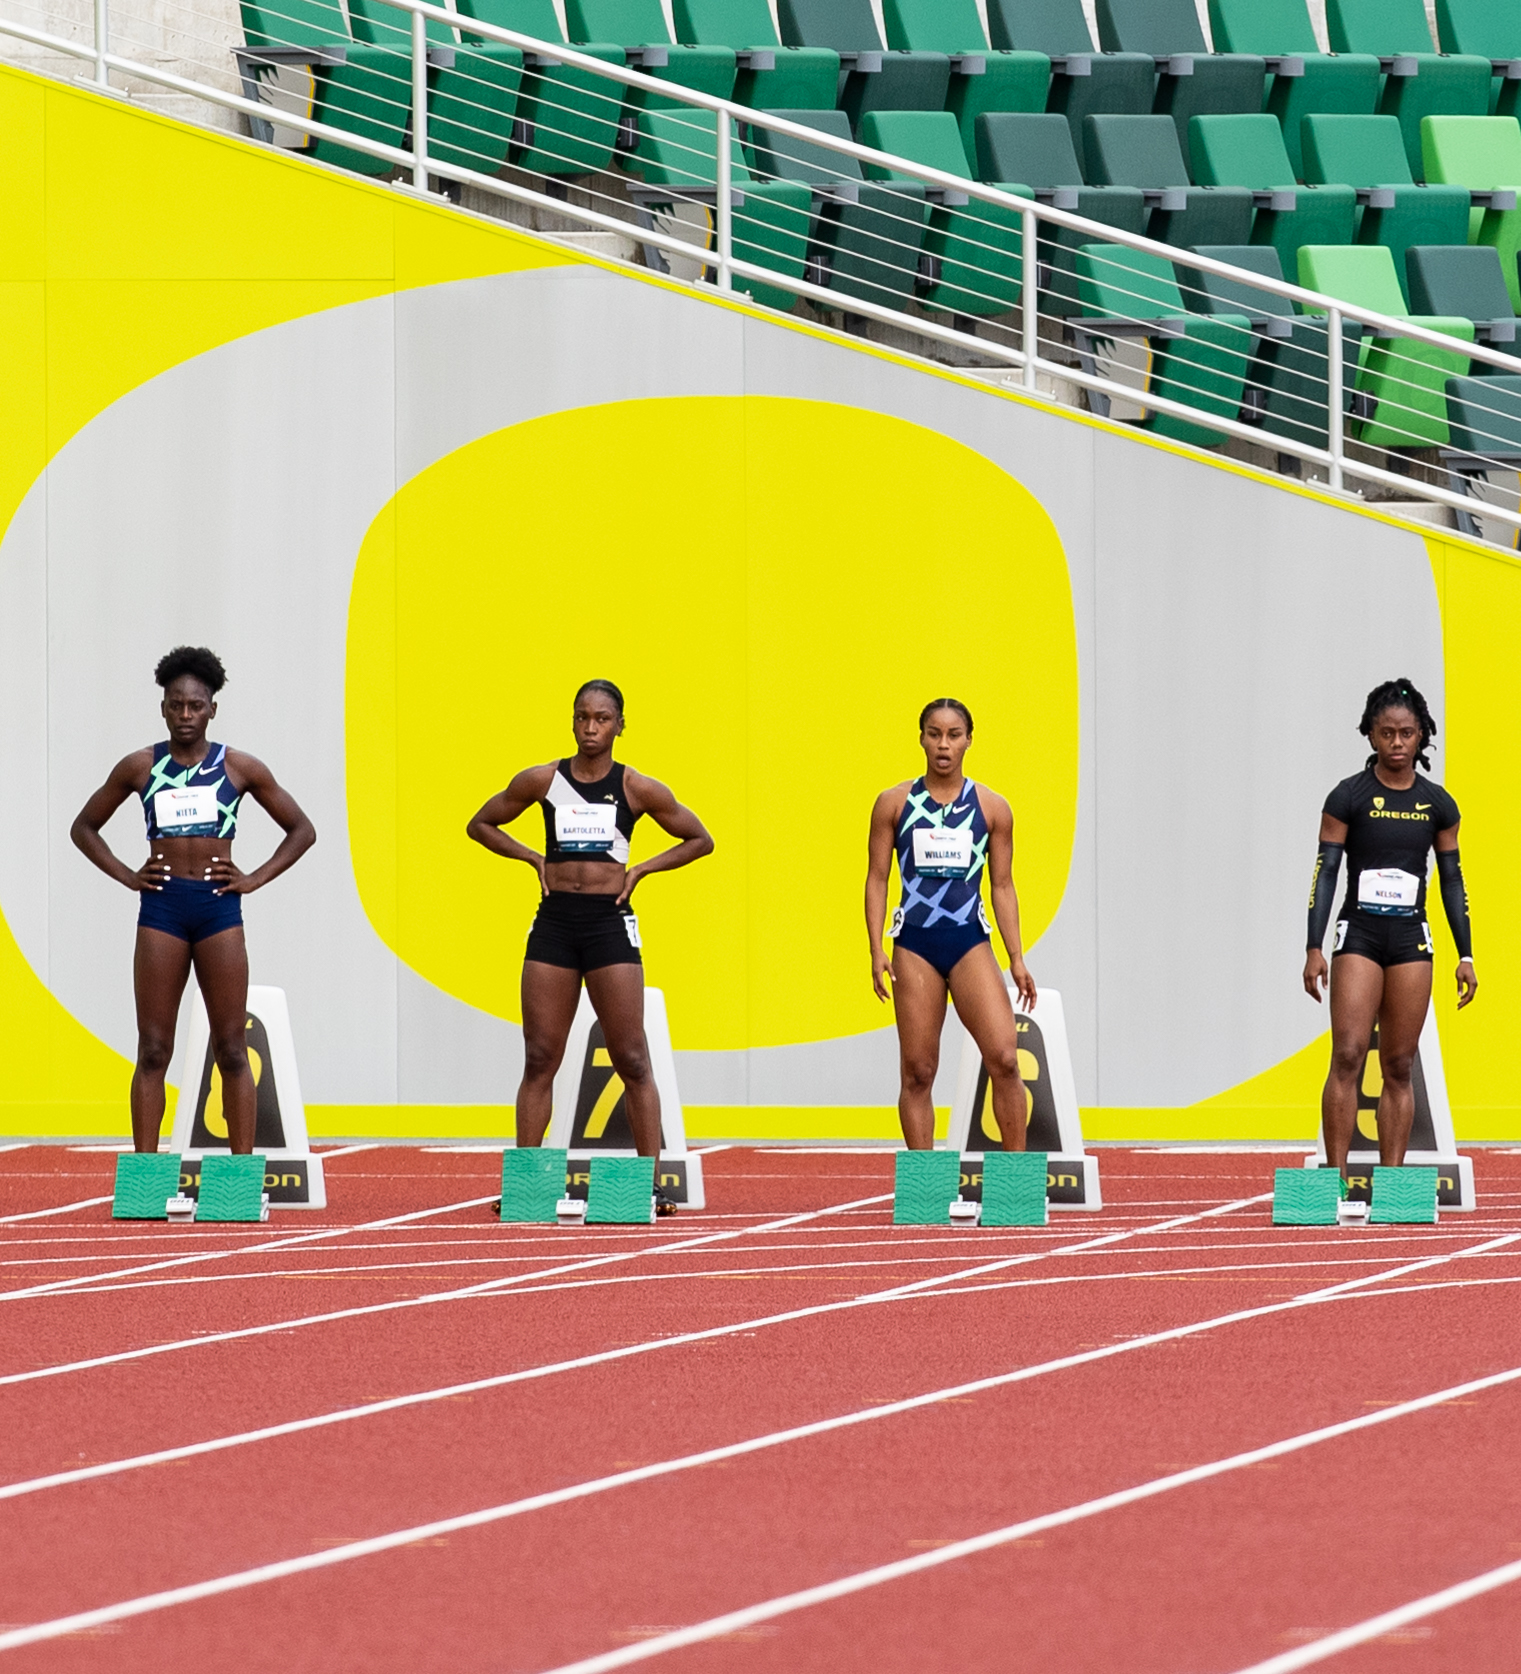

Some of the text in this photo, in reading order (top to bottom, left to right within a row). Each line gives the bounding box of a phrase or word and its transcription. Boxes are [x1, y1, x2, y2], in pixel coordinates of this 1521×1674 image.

[563, 827, 606, 835] BARTOLETTA
[924, 850, 962, 860] WILLIAMS
[1375, 890, 1402, 899] NELSON
[628, 919, 638, 944] 7
[583, 1047, 626, 1139] 7
